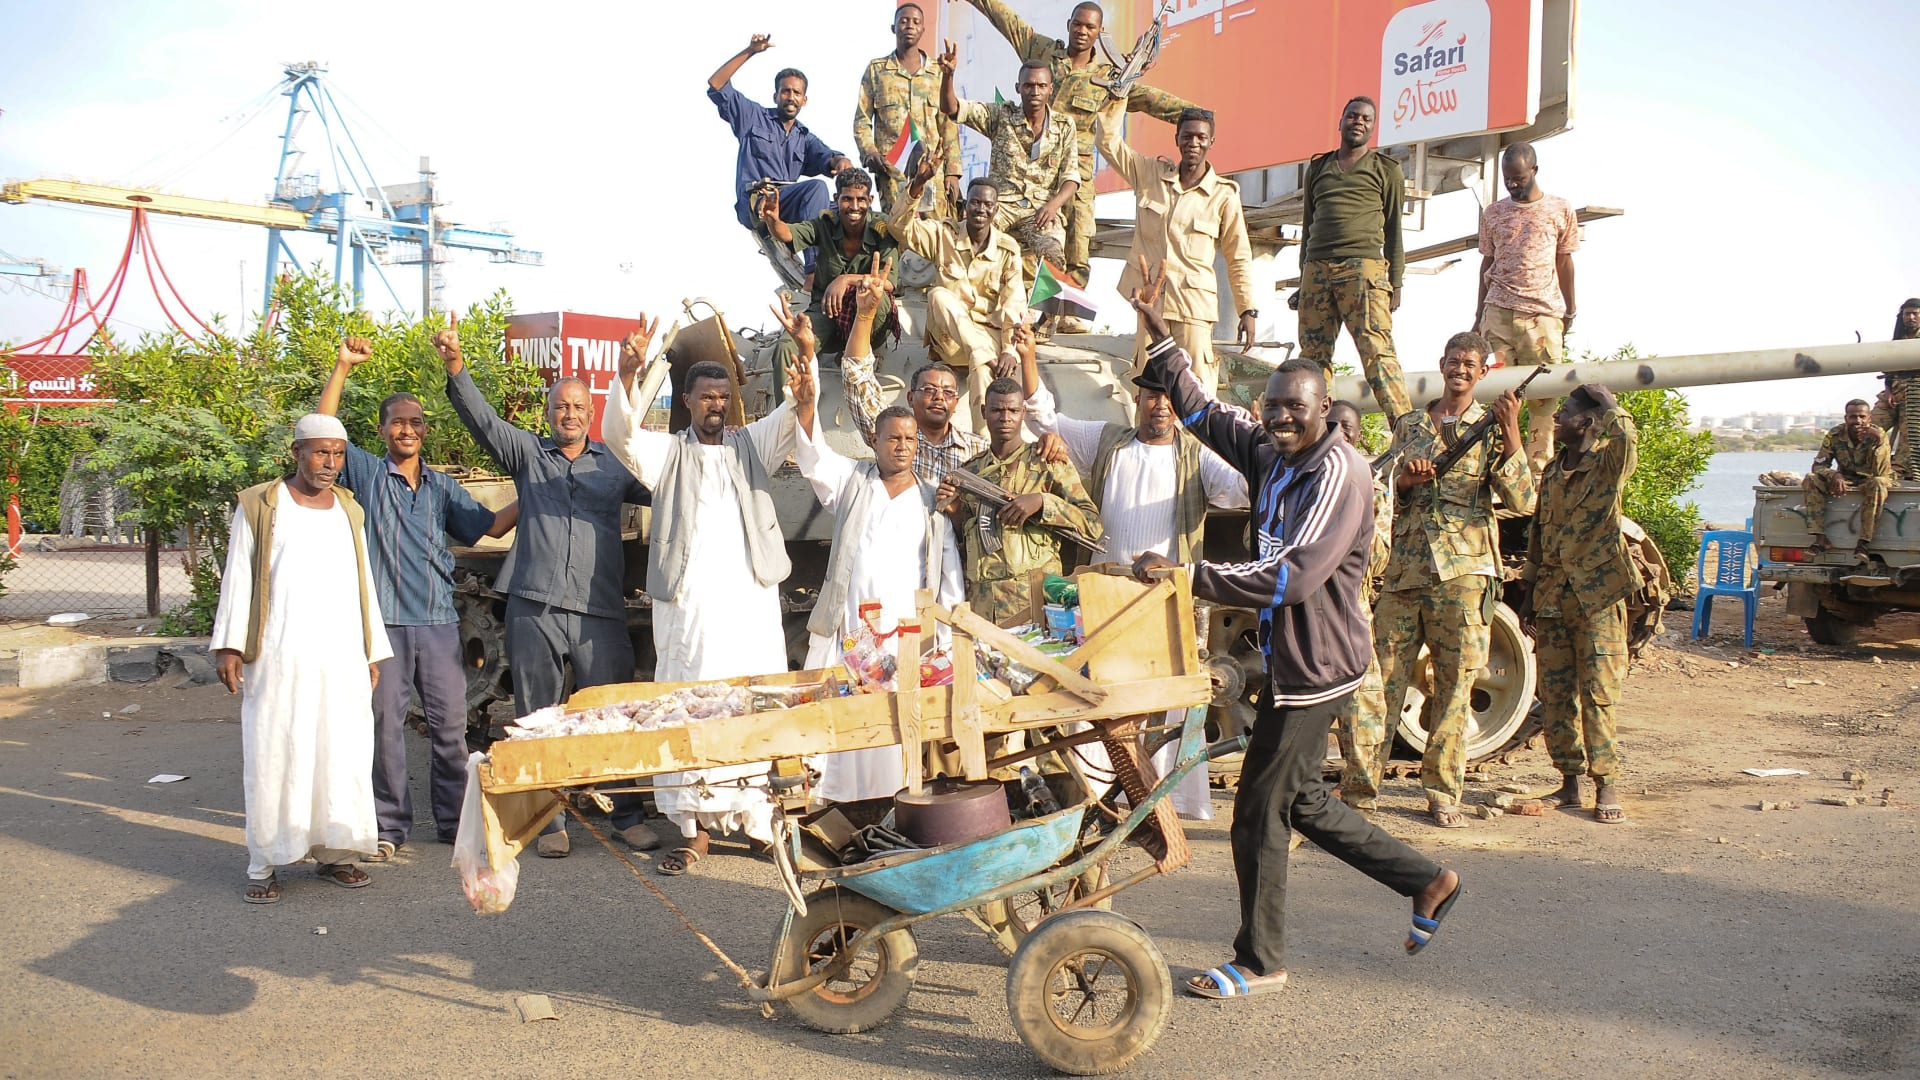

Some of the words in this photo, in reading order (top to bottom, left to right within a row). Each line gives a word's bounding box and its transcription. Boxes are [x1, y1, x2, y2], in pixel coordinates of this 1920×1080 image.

[1394, 33, 1467, 75] Safari
[1394, 80, 1457, 129] سفاري
[510, 336, 561, 369] TWINS
[567, 337, 621, 373] TWIN
